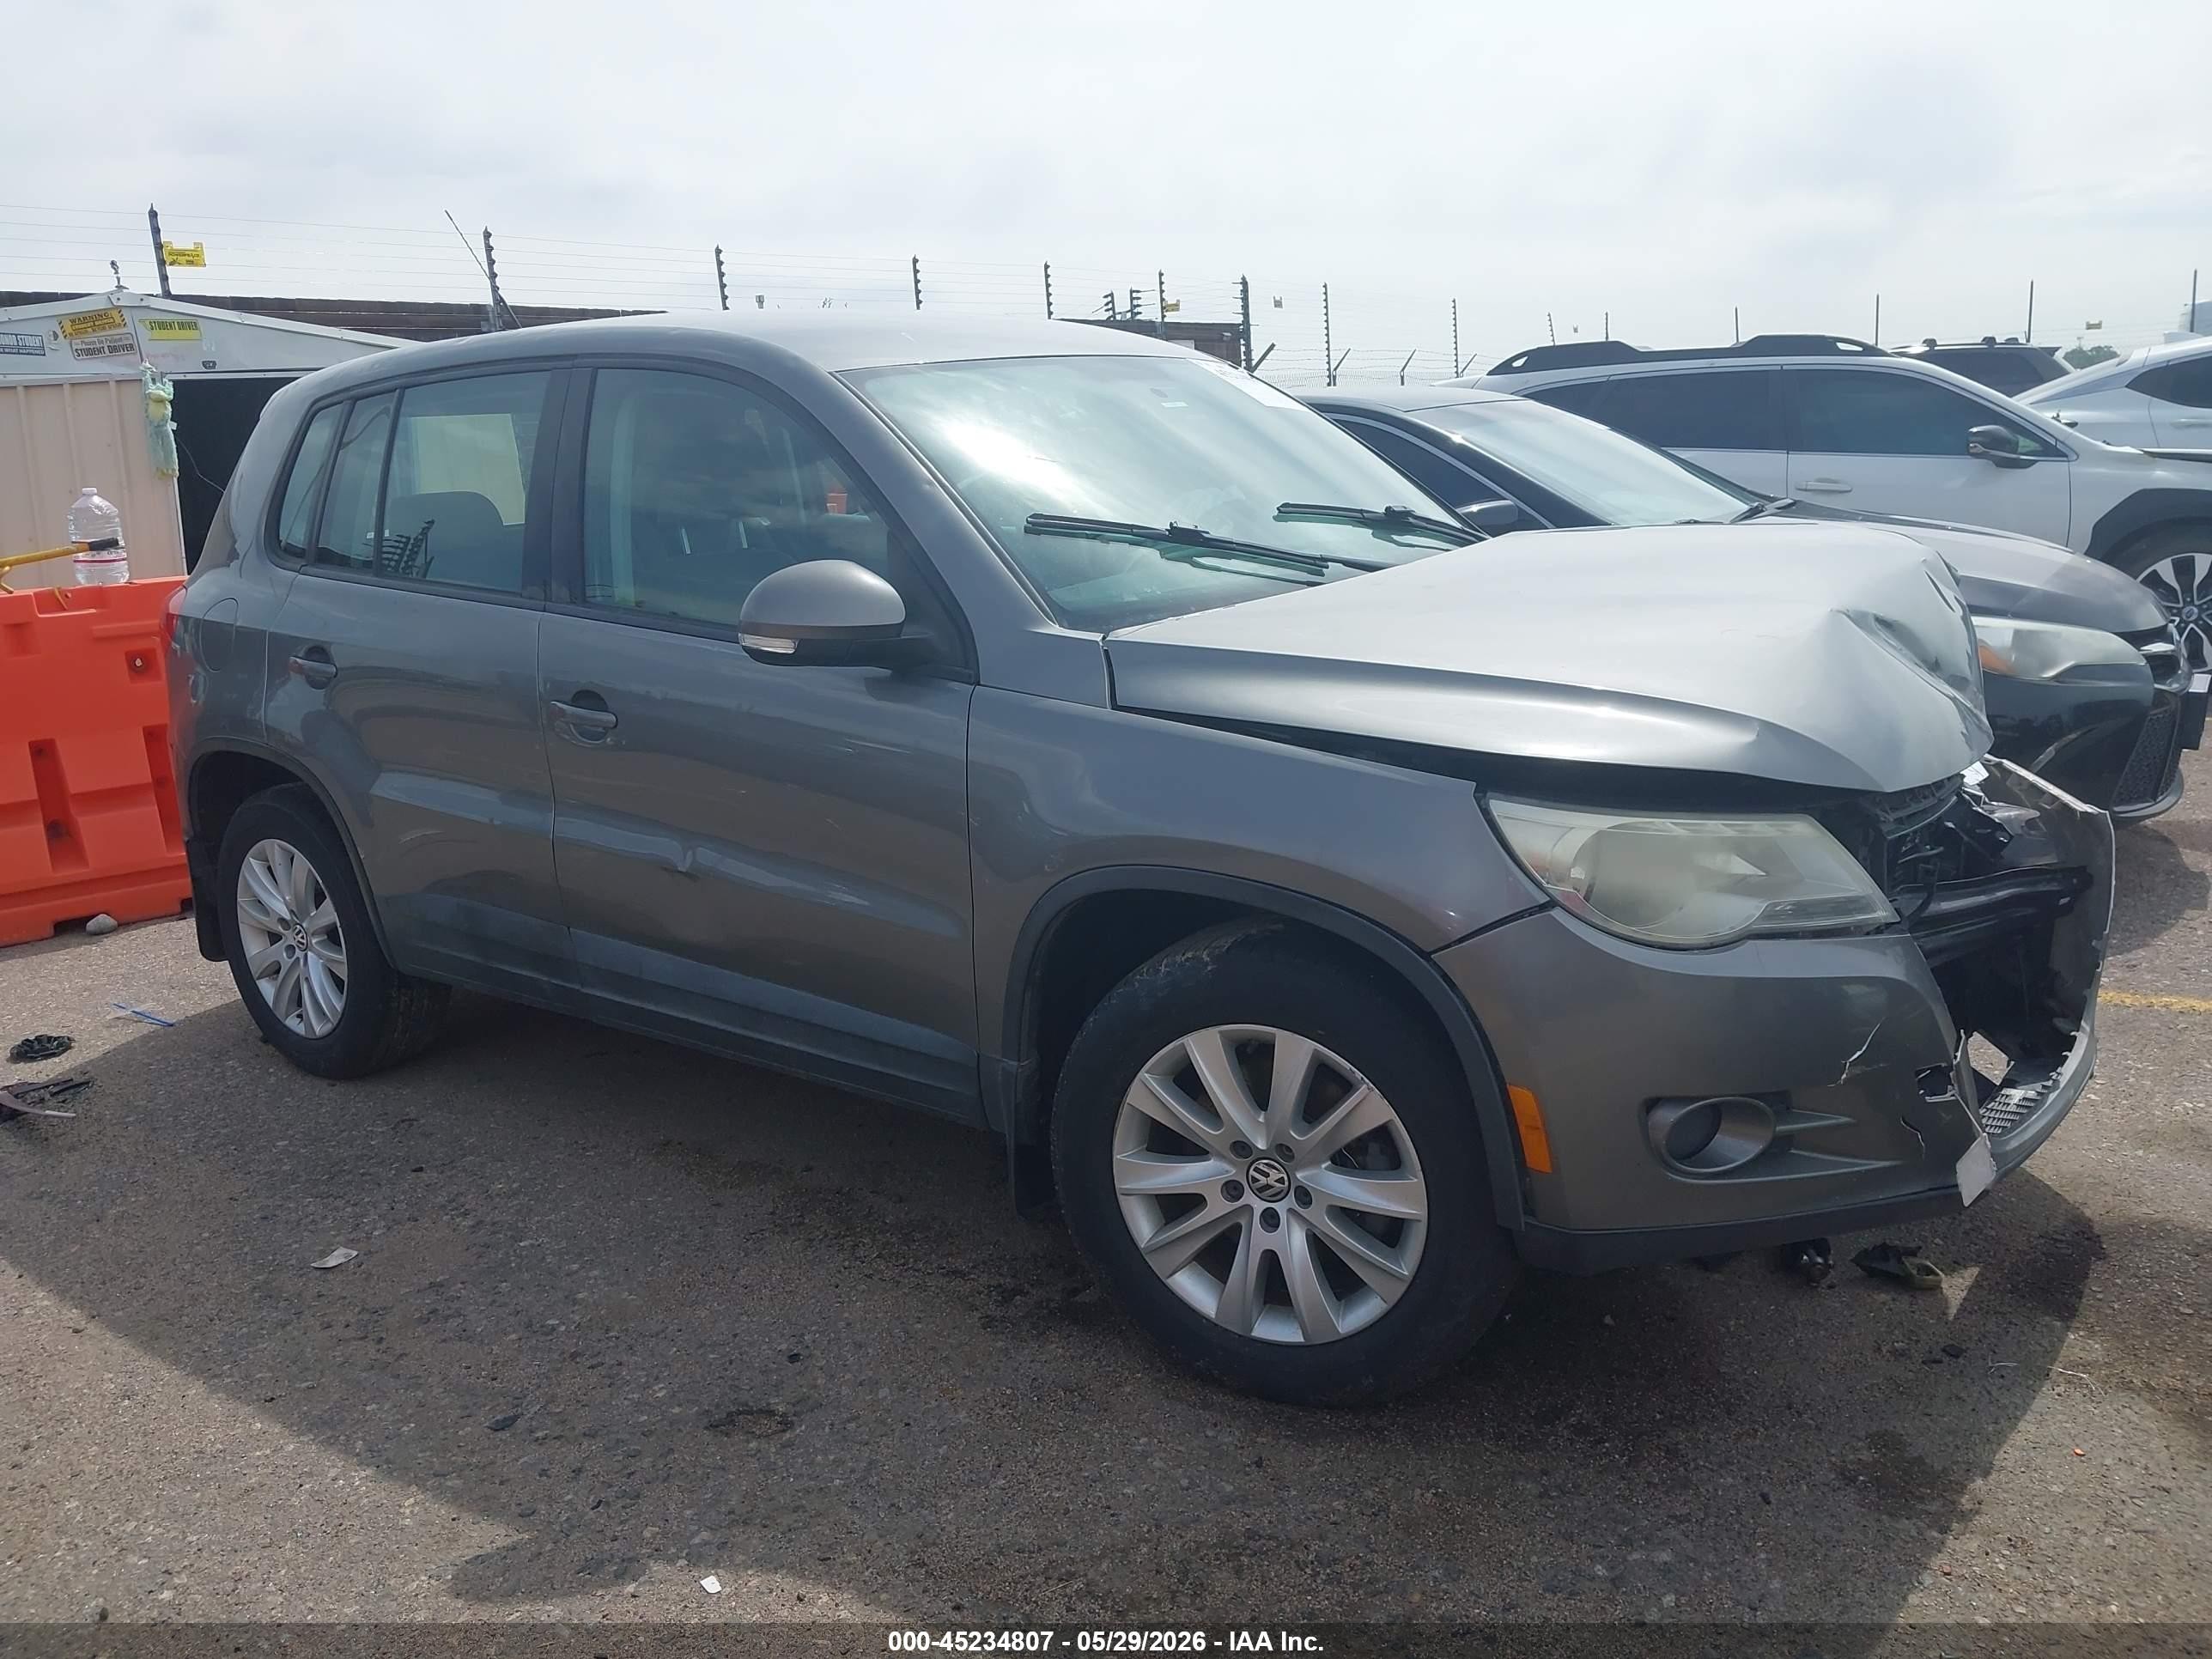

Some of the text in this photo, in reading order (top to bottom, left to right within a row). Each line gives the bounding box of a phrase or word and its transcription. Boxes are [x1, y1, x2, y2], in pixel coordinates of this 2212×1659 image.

[70, 312, 110, 324] WARNING
[149, 320, 198, 331] STUDENT DRIVER
[0, 334, 43, 347] ONOR STUDENT
[75, 343, 135, 358] STUDENT DRIVER
